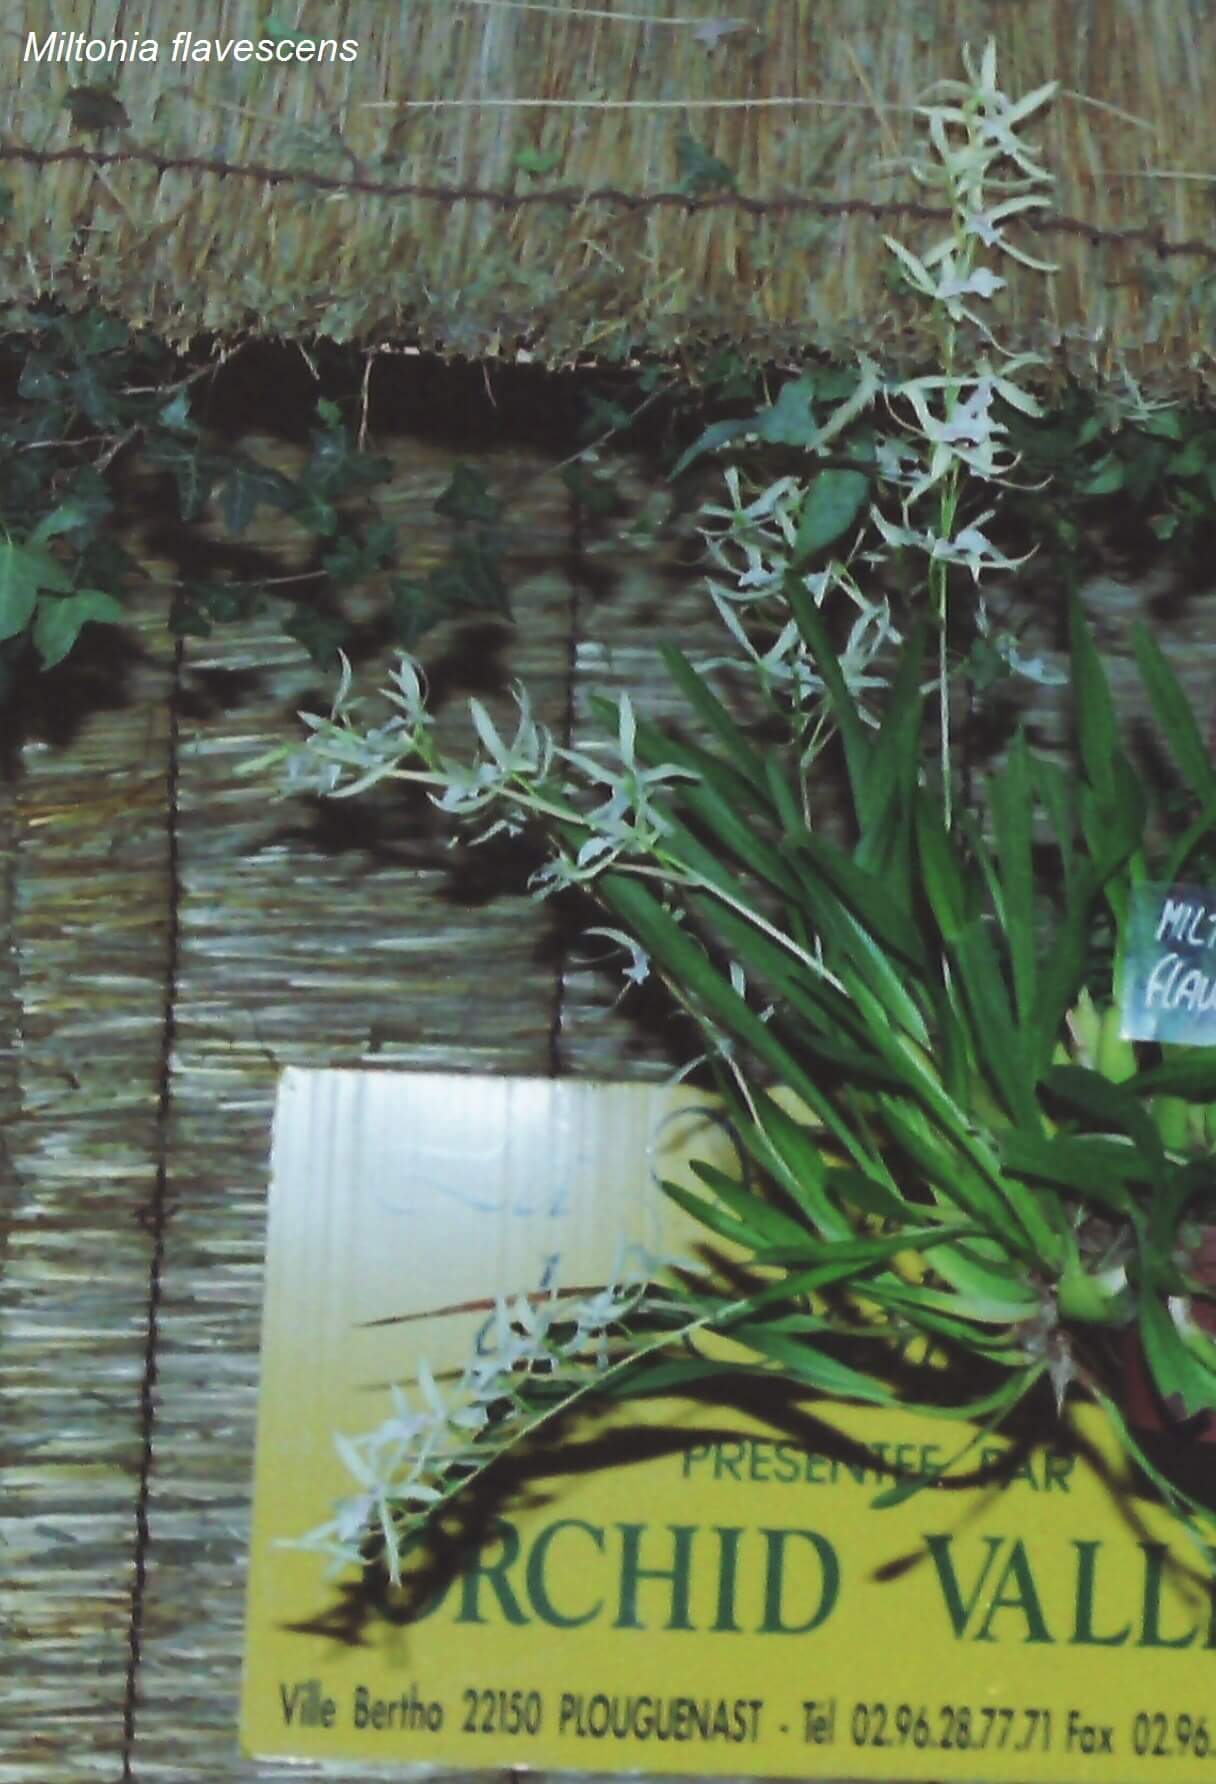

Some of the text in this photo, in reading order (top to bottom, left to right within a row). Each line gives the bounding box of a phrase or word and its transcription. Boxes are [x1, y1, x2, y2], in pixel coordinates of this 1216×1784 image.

[279, 1680, 337, 1728] Ville
[354, 1682, 443, 1732] Bertho
[461, 1689, 542, 1735] 22150
[559, 1693, 763, 1742] PLOUGUENAST
[851, 1702, 1052, 1752] 02.96.28.77.71
[1067, 1708, 1113, 1754] Fax
